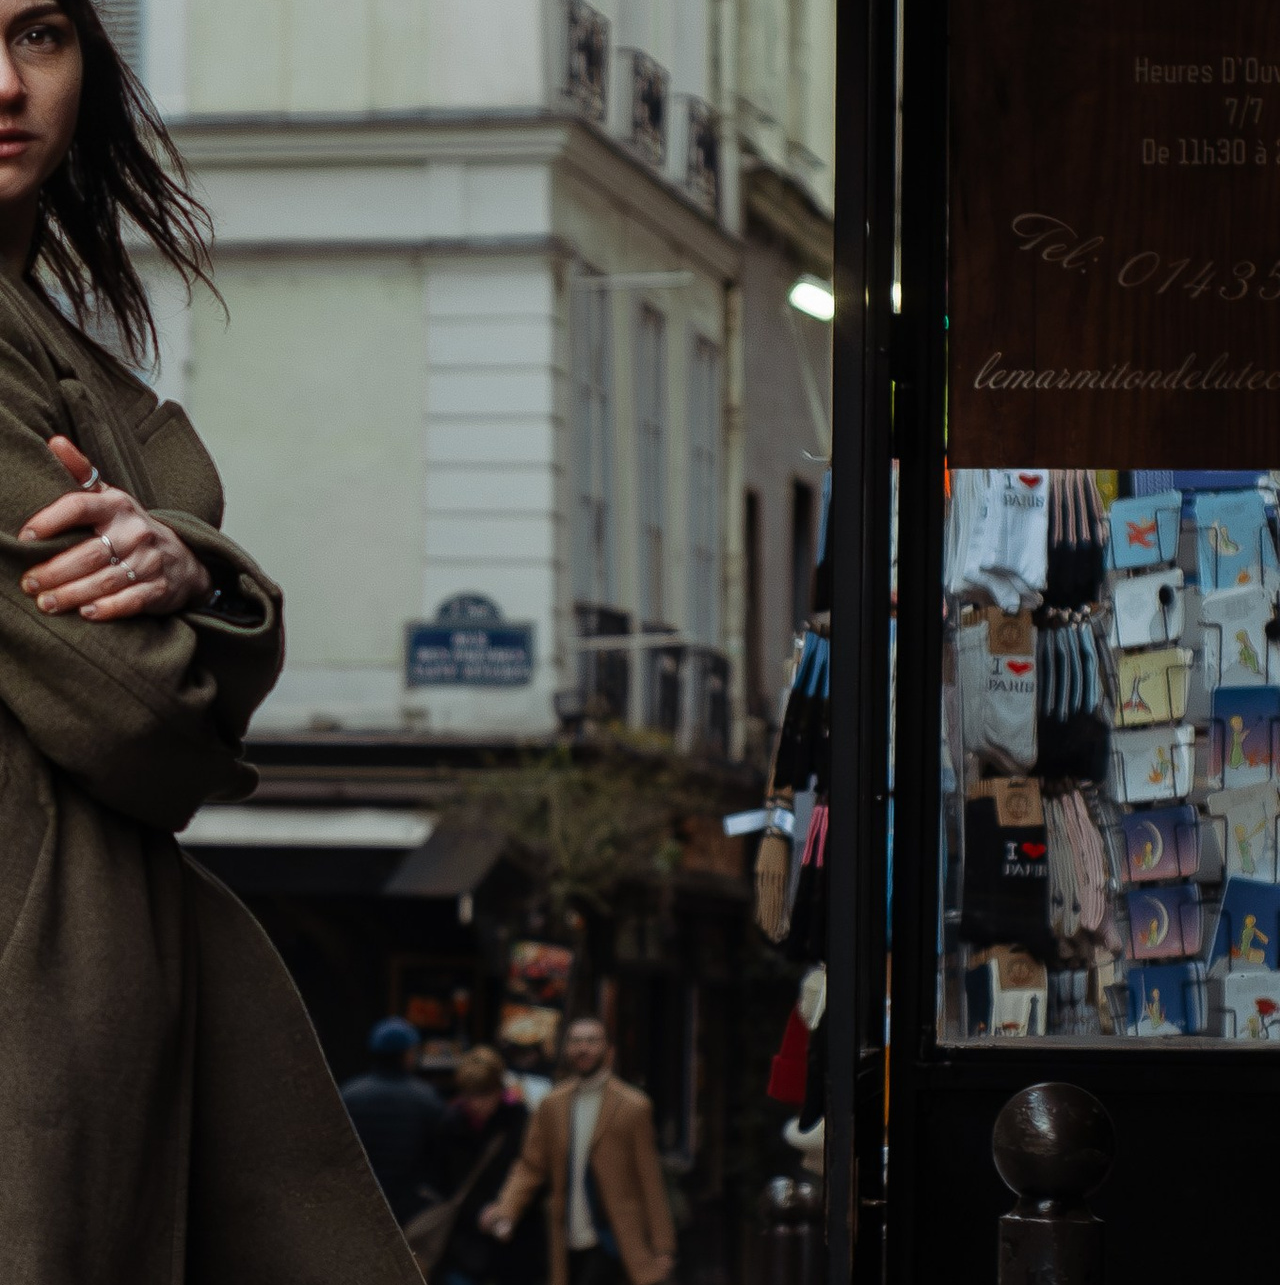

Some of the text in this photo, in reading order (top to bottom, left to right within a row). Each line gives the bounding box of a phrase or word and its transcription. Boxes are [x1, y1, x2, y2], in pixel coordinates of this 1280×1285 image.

[1134, 56, 1213, 84] Heures
[1224, 95, 1264, 130] 7/7
[1142, 137, 1170, 165] De
[1178, 137, 1246, 165] 11h30
[1255, 138, 1268, 165] à
[1005, 840, 1019, 861] I
